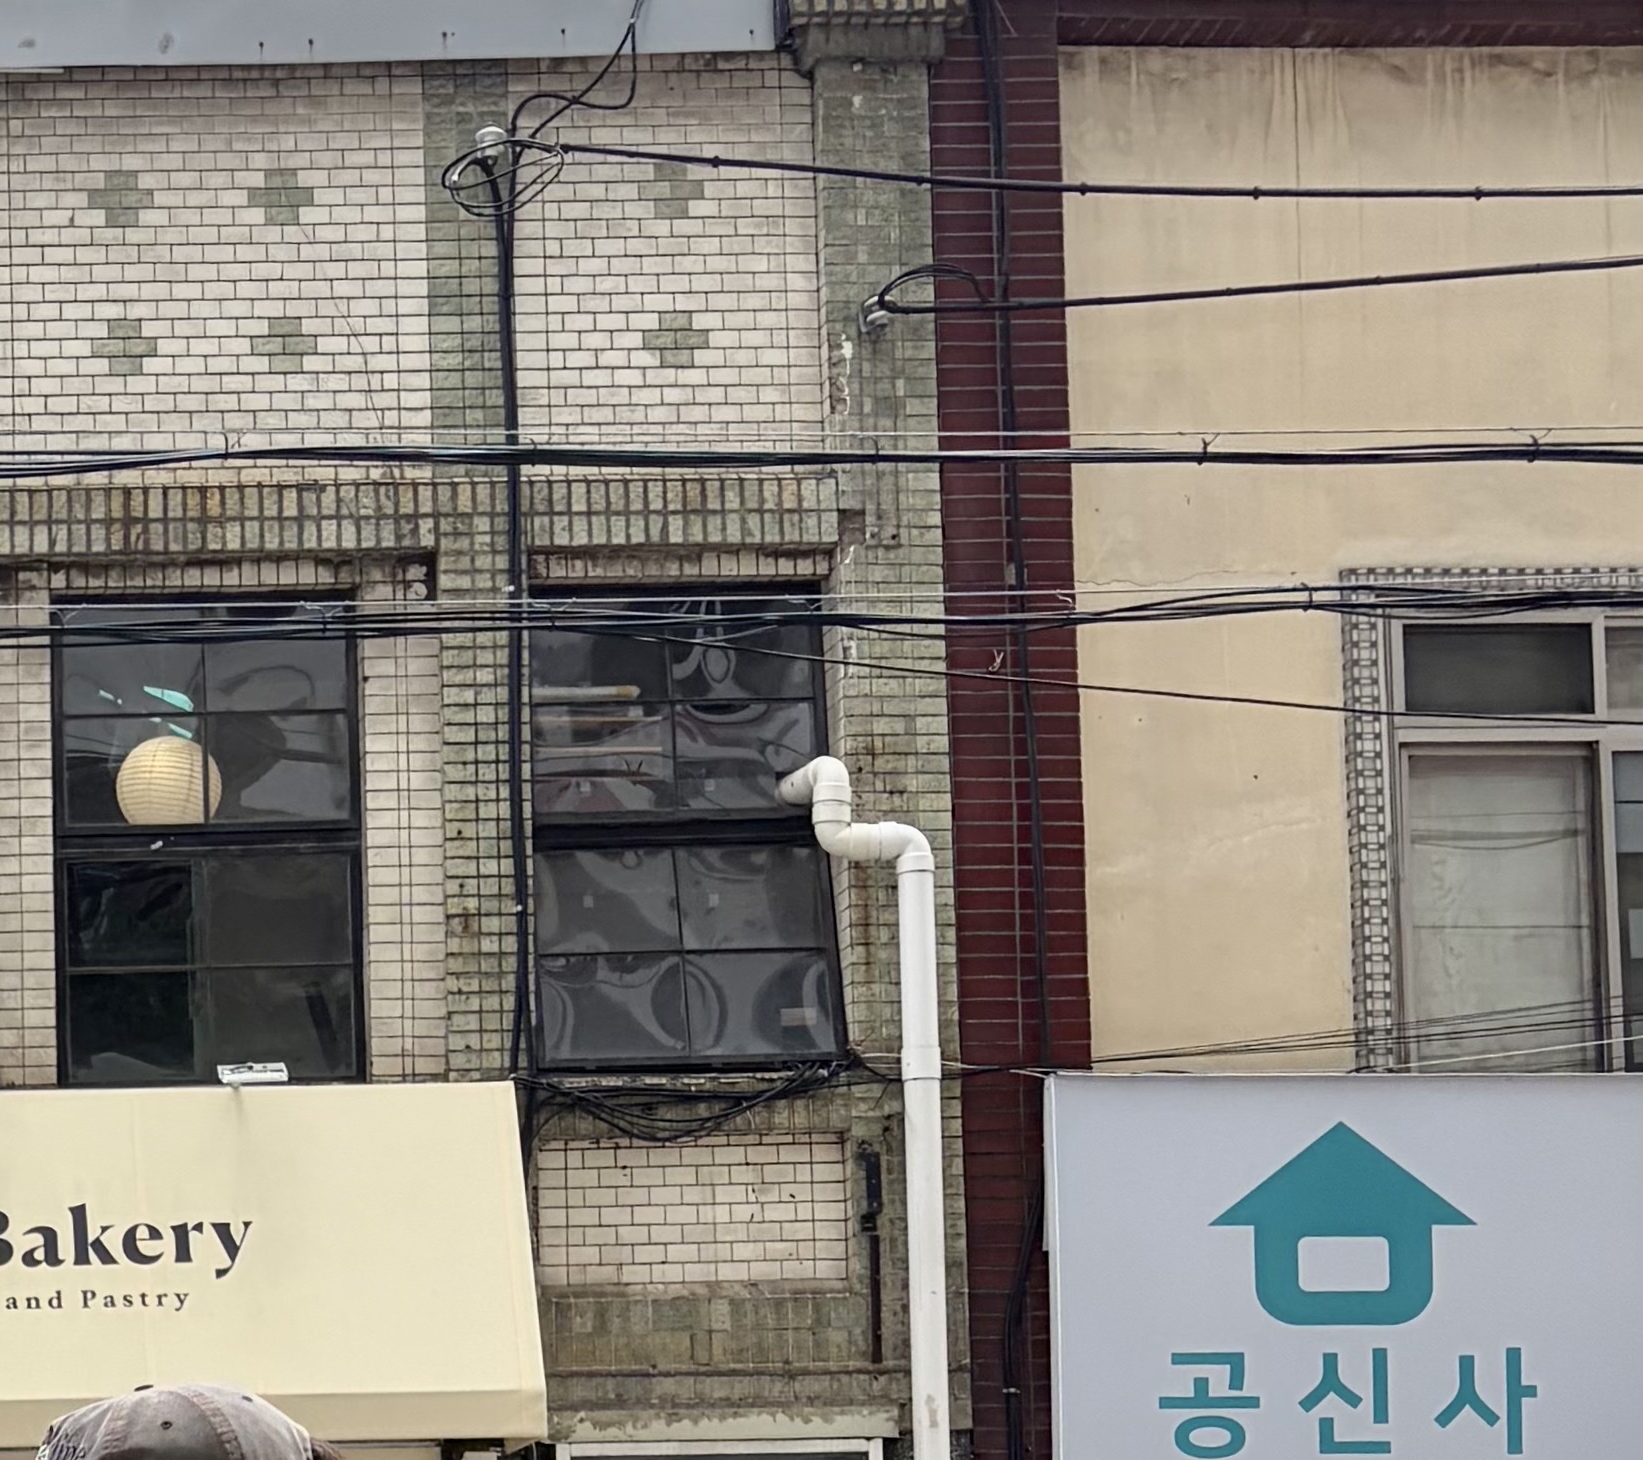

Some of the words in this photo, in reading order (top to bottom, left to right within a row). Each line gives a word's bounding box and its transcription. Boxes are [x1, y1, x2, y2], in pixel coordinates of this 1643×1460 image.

[5, 1289, 64, 1311] and
[81, 1288, 191, 1312] Pastry
[1158, 1346, 1538, 1459] 공신사
